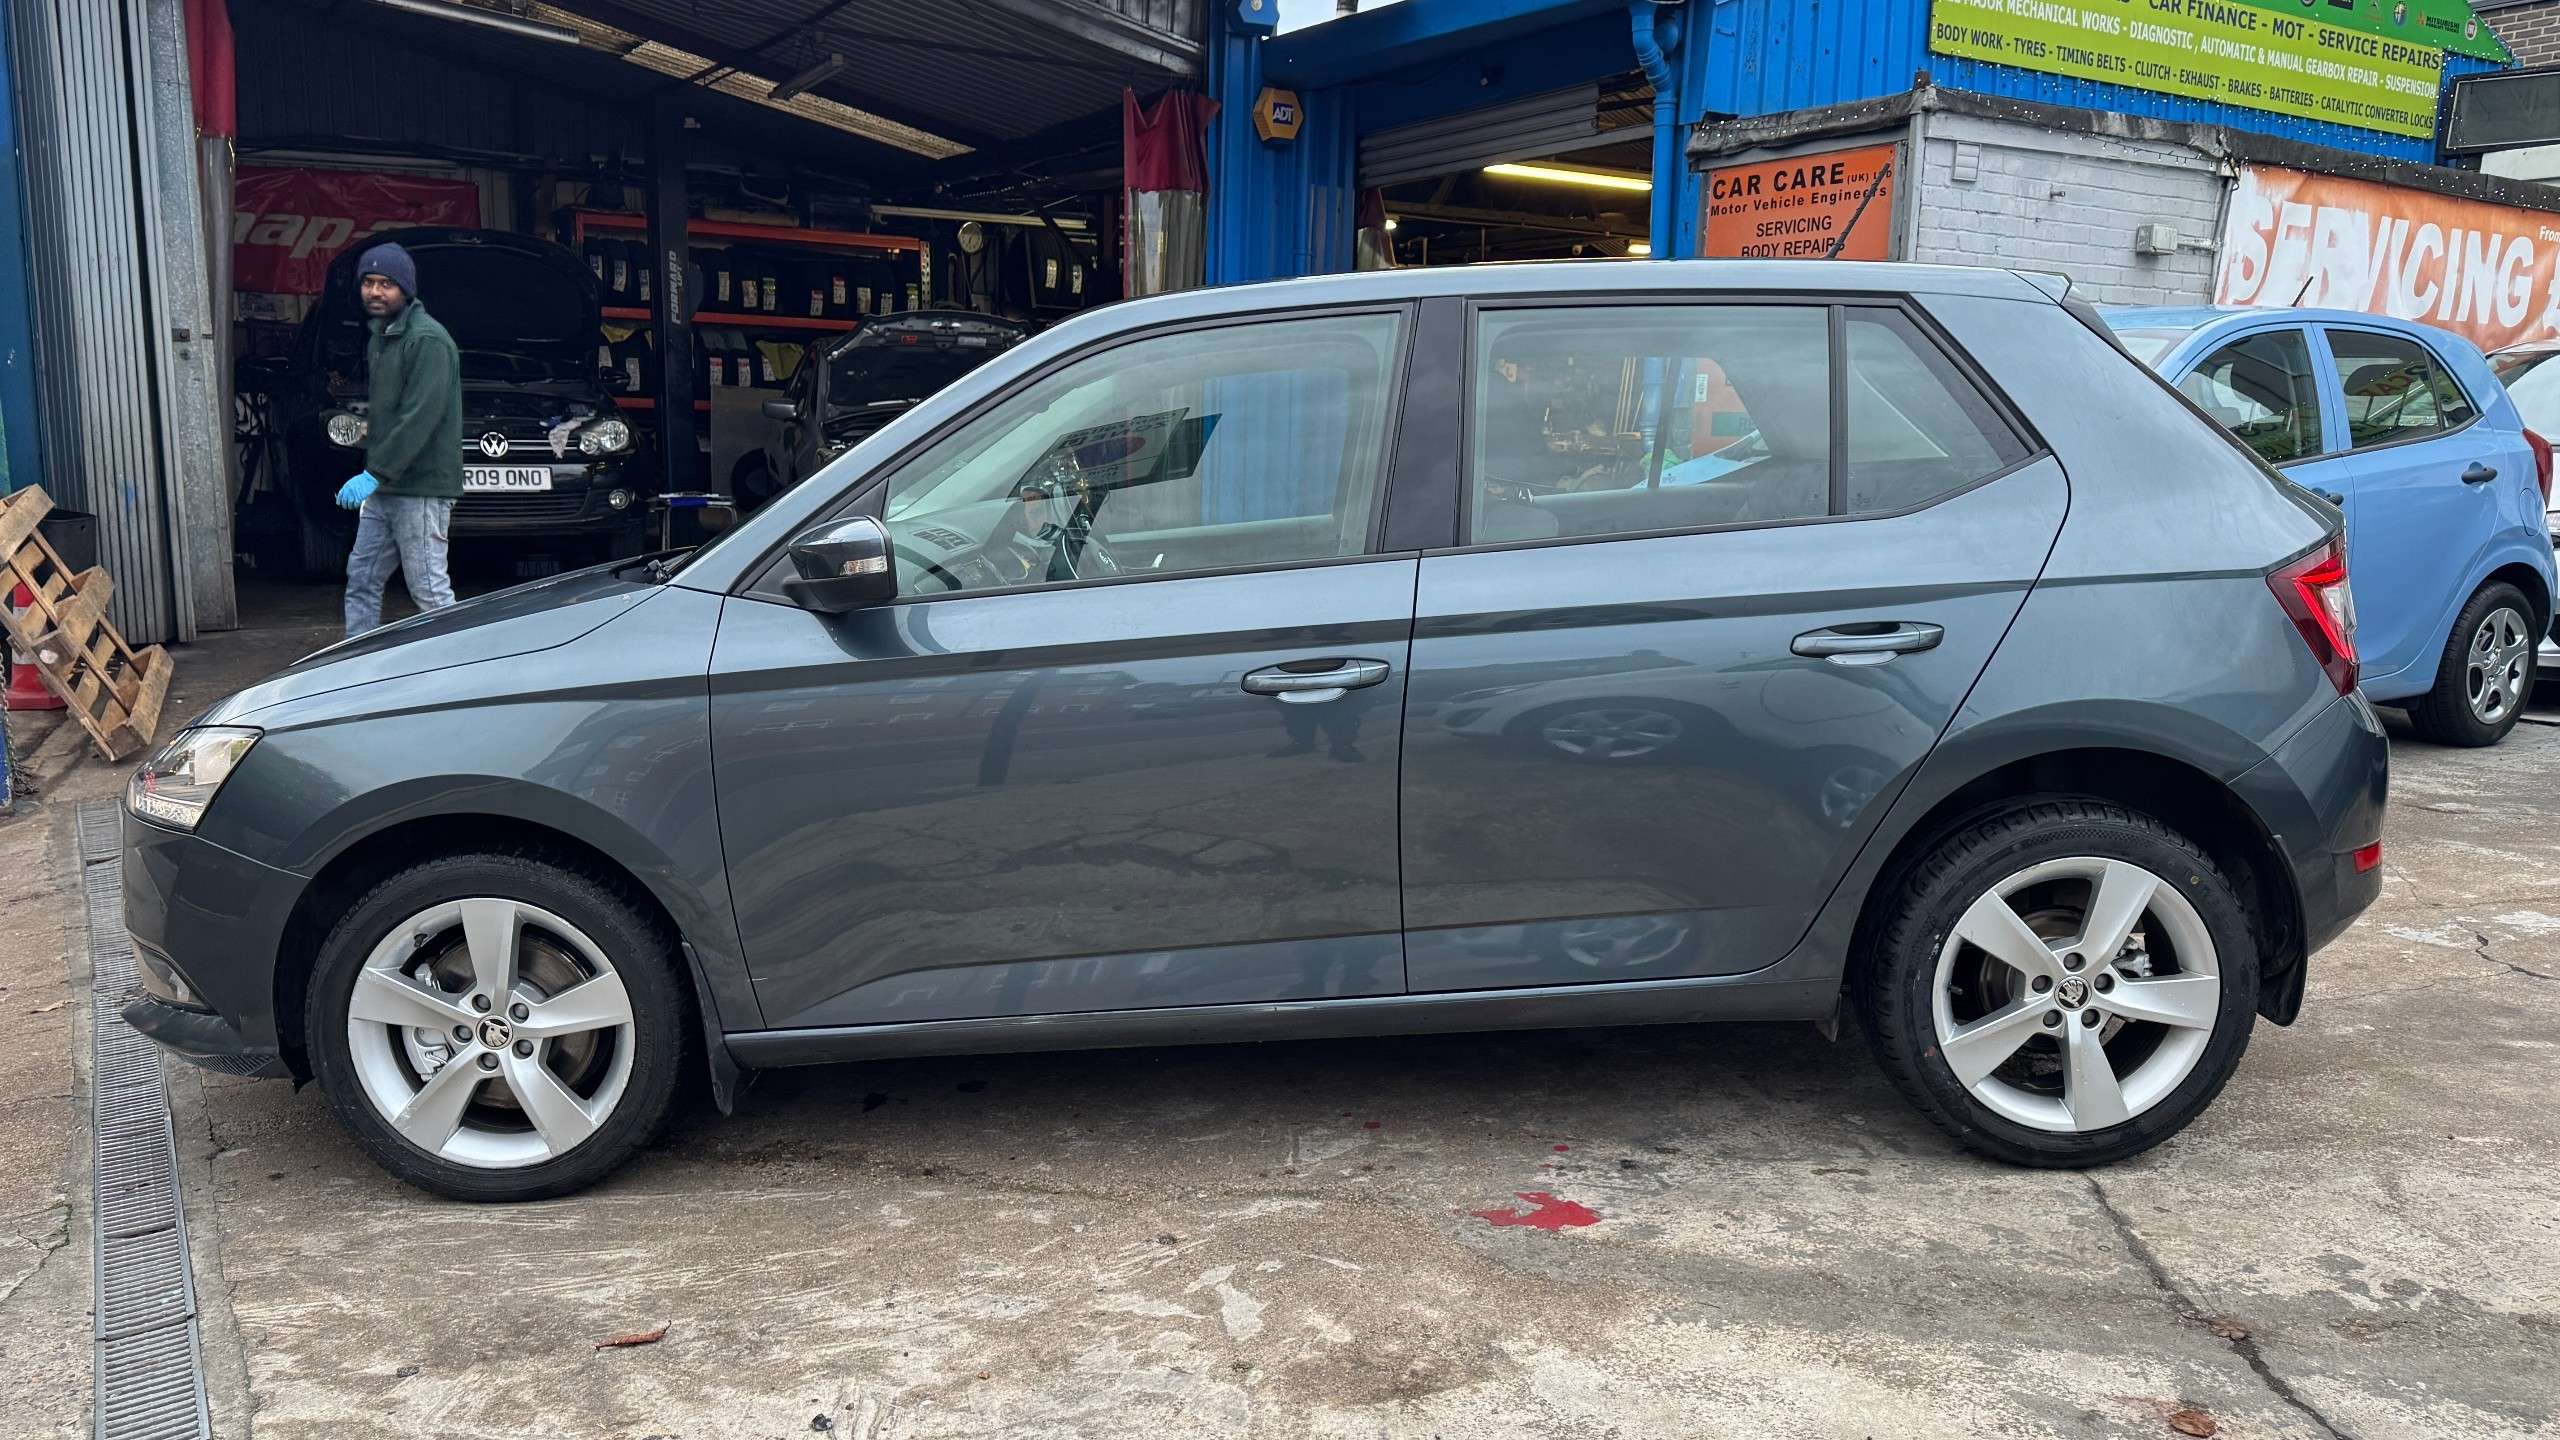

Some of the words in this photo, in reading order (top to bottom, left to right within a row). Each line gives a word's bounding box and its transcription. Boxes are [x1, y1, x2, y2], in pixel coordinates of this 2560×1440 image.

[2006, 0, 2078, 26] MECHANICAL
[2081, 11, 2121, 35] WORKS
[2129, 20, 2193, 49] DIAGNOSTIC
[2200, 36, 2256, 62] AUTOMATIC
[2257, 48, 2265, 65] &
[2267, 49, 2304, 72] MANUAL
[2306, 58, 2346, 80] GEARBOX
[2348, 67, 2378, 87] REPAIR
[2385, 74, 2436, 98] SUSPENSION
[2149, 0, 2182, 14] CAR
[2187, 0, 2257, 31] FINANCE
[2272, 18, 2305, 40] MOT
[2318, 28, 2378, 57] SERVICE
[2382, 43, 2440, 70] REPAIRS
[1936, 23, 1968, 43] BODY
[1970, 29, 2004, 50] WORK
[2014, 37, 2046, 57] TYRES
[2056, 45, 2094, 67] TIMING
[2097, 53, 2126, 73] BELTS
[2135, 60, 2171, 80] CLUTCH
[2179, 69, 2221, 90] EXHAUST
[2228, 78, 2262, 97] BRAKES
[2269, 86, 2314, 107] BATTERIES
[2321, 96, 2363, 116] CATALYTIC
[2365, 104, 2409, 125] CONVERTER
[2410, 113, 2434, 129] LOCKS
[1273, 105, 1295, 122] ADT
[1712, 174, 1761, 200] CAR
[1773, 162, 1845, 190] CARE
[1846, 173, 1869, 185] (UK)
[1873, 169, 1892, 180] LD
[1710, 203, 1747, 216] Motor
[1753, 195, 1805, 211] Vehicle
[1811, 186, 1887, 205] Engineers
[1756, 215, 1832, 238] SERVICING
[1742, 242, 1780, 257] BODY
[2228, 194, 2534, 328] SERVICING
[668, 249, 681, 325] FORWARD
[505, 469, 542, 486] ONO
